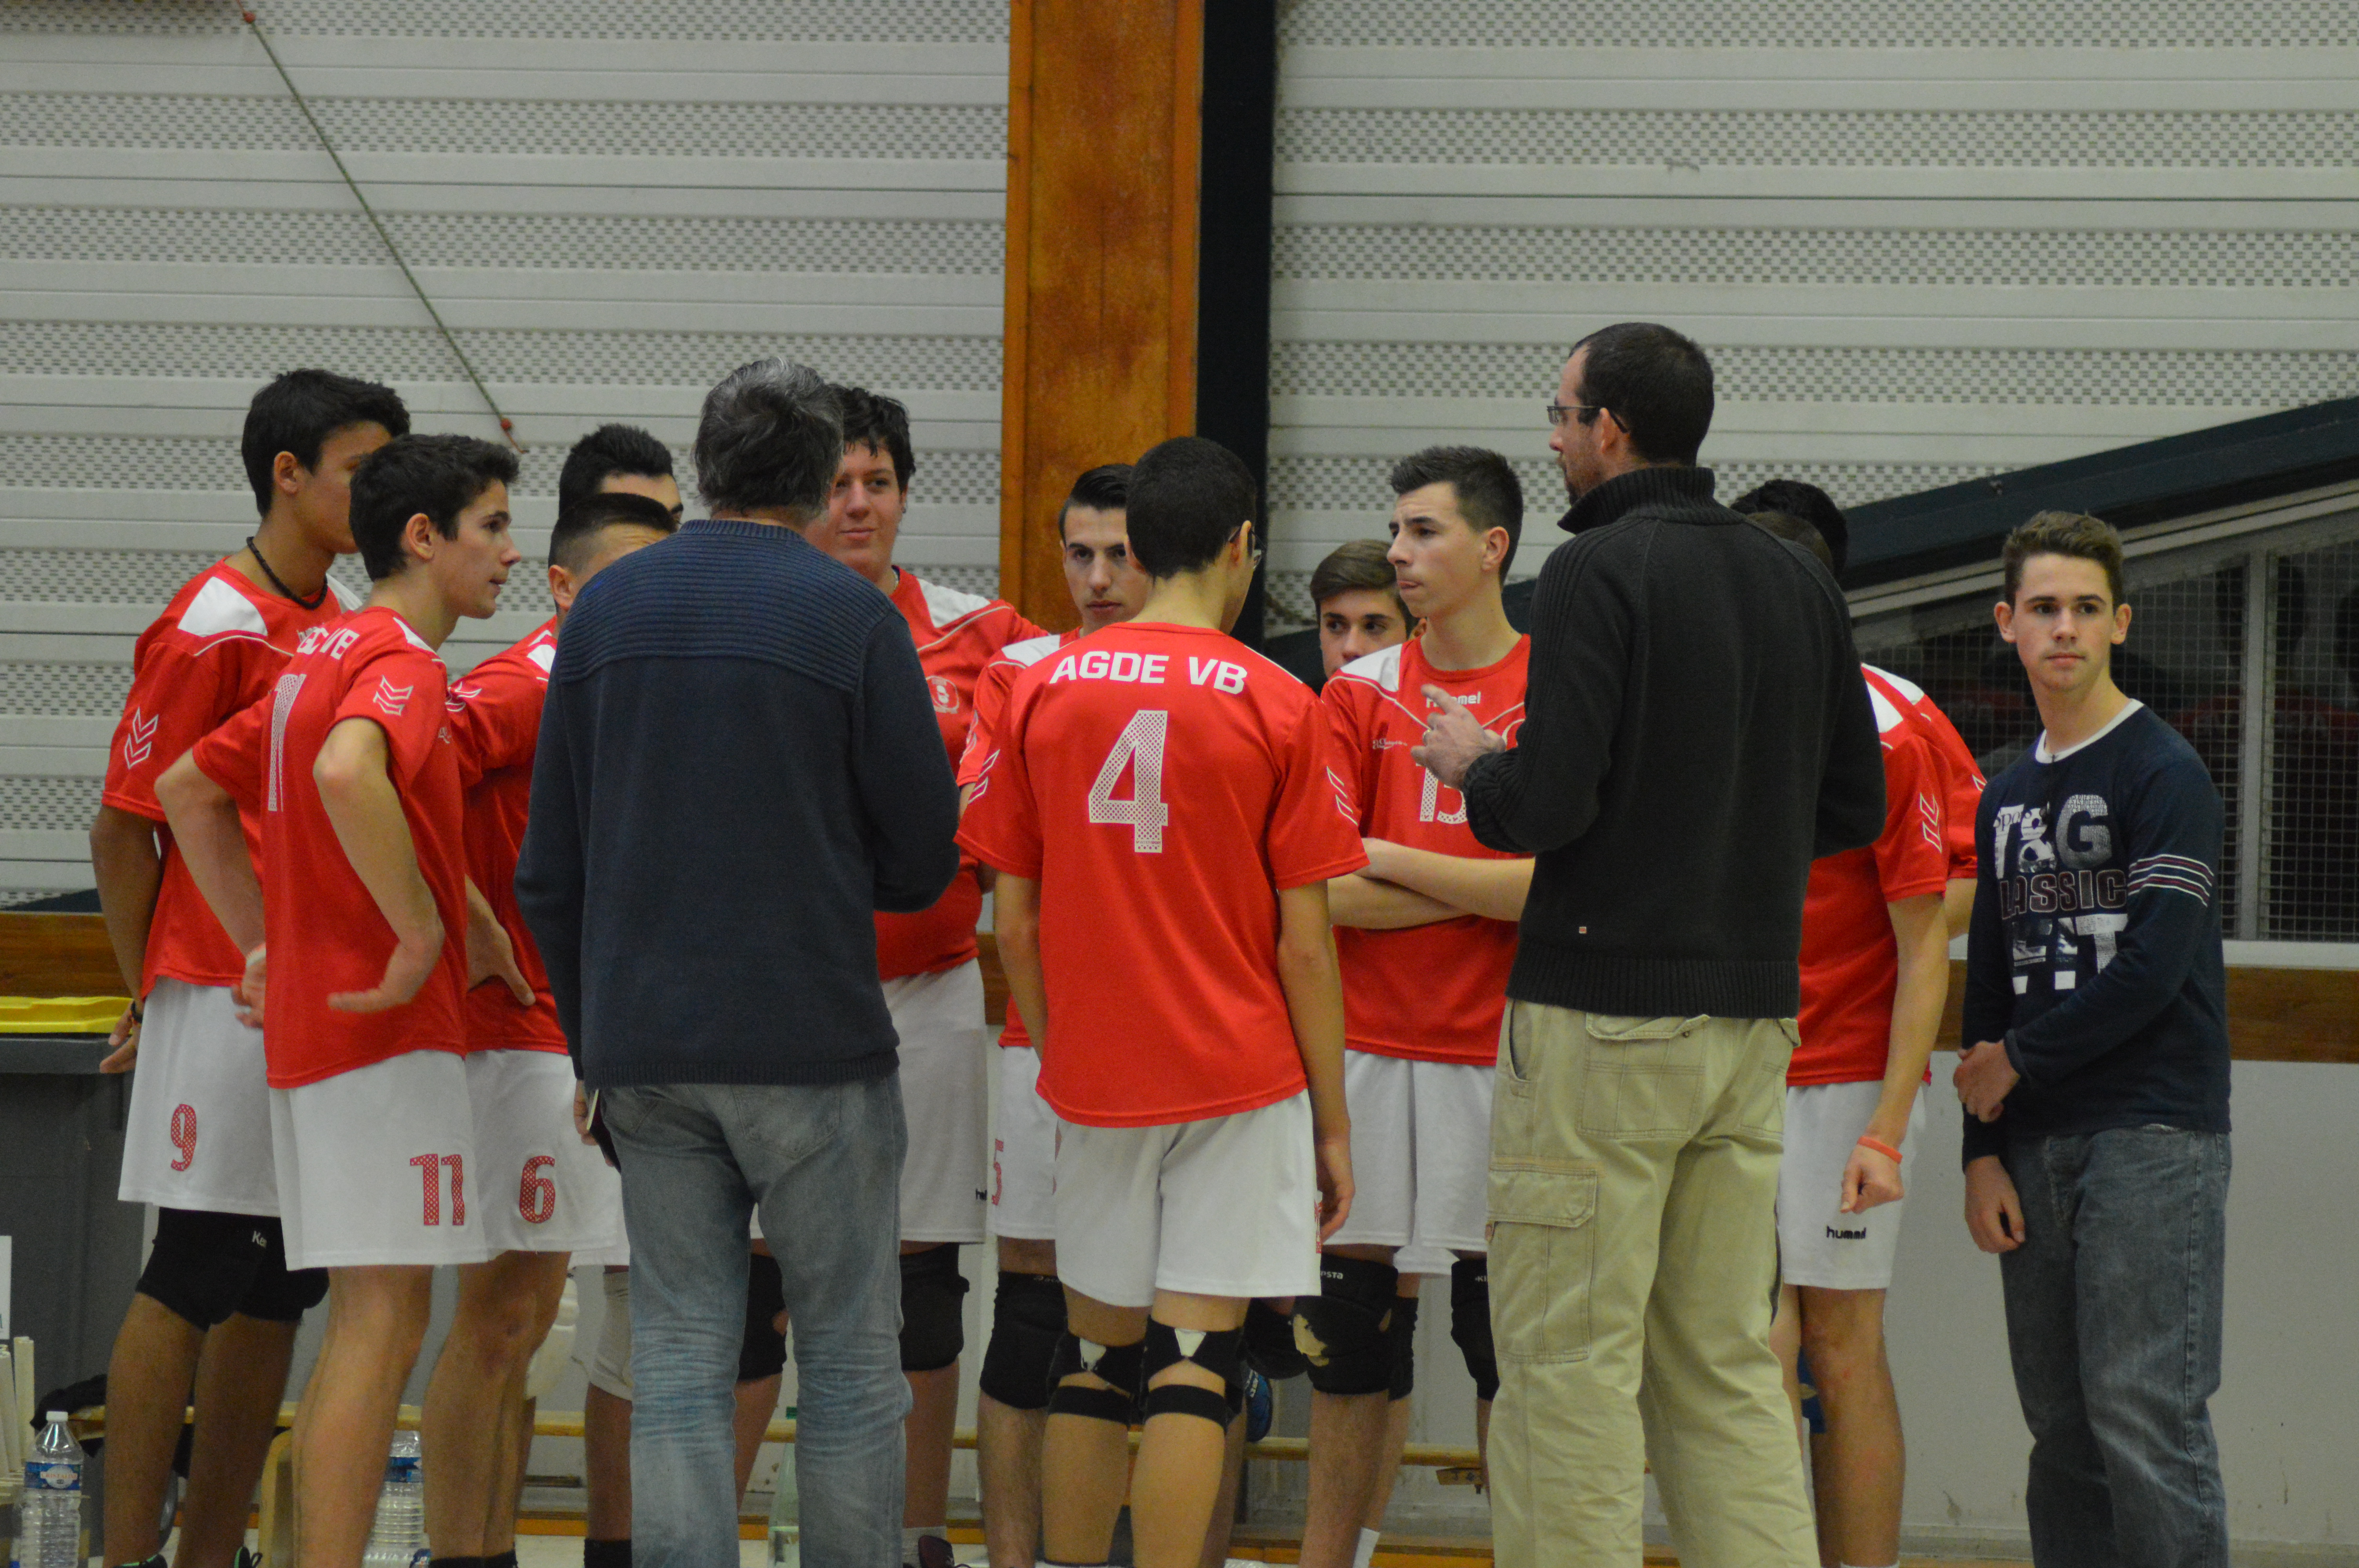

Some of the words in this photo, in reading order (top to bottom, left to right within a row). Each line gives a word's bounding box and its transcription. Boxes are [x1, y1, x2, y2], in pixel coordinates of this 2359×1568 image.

[1049, 651, 1169, 684] AGDE
[1189, 657, 1247, 695] VB
[1088, 710, 1168, 853] 4
[2001, 870, 2127, 920] LASSIC
[171, 1103, 197, 1172] 9
[410, 1153, 465, 1226] 11
[518, 1155, 556, 1223] 6
